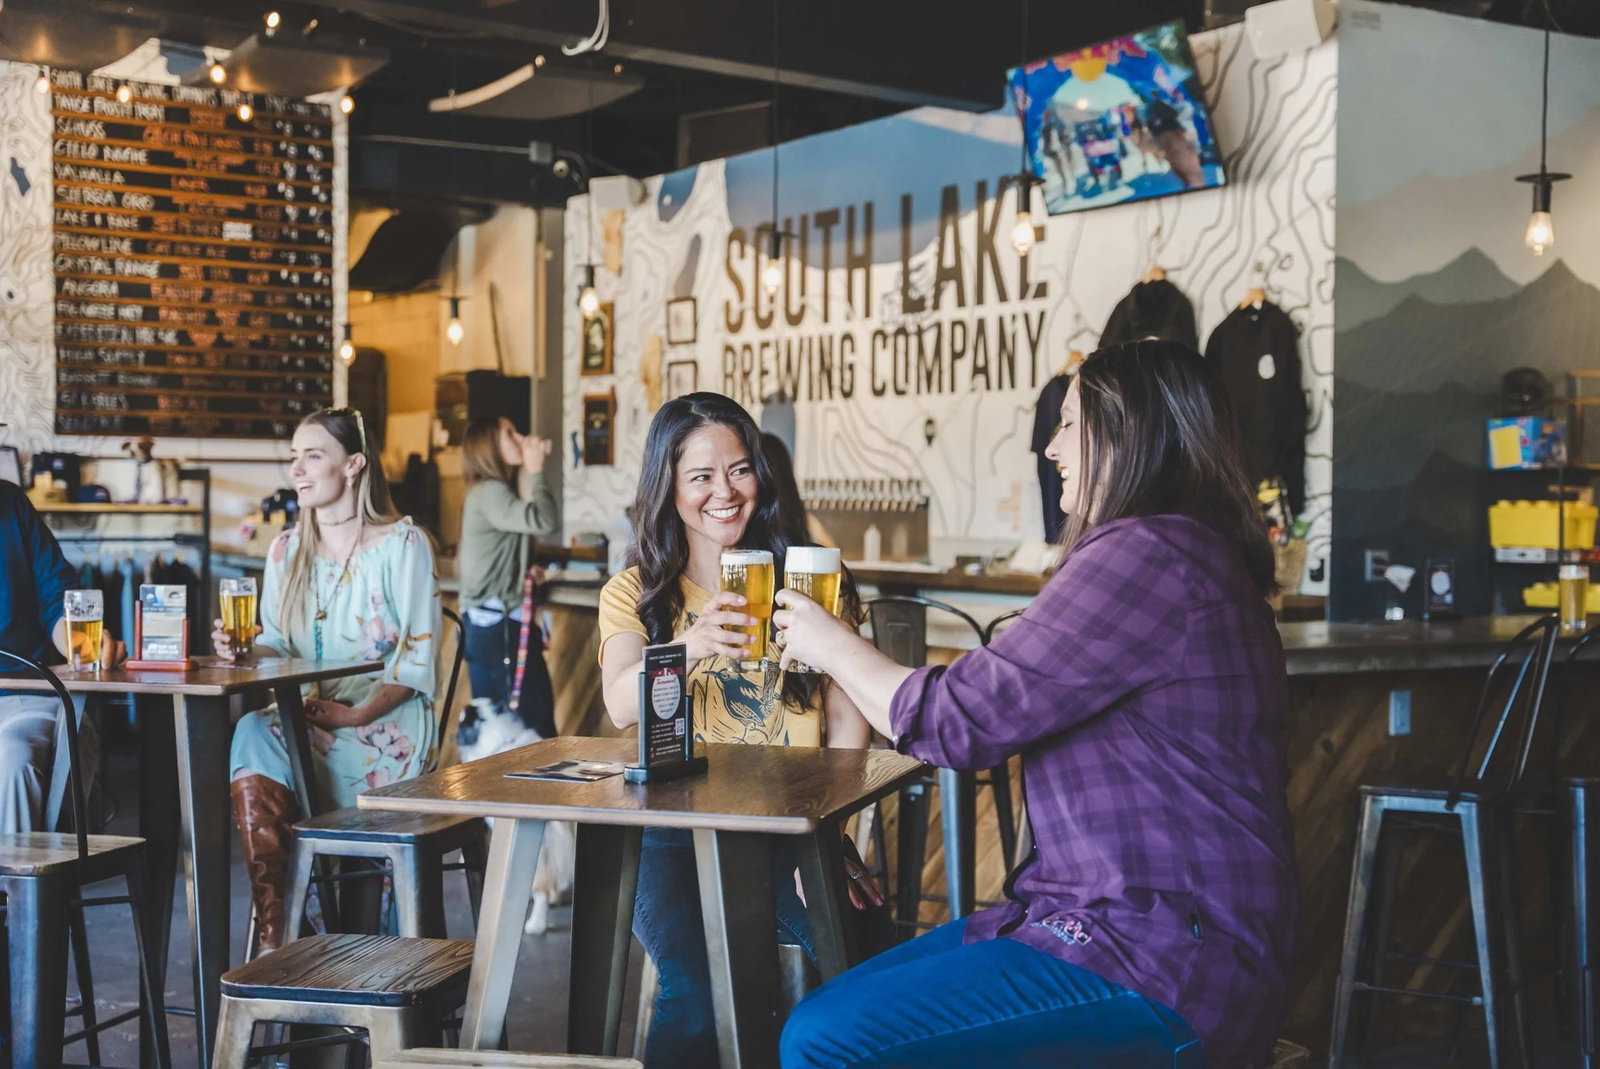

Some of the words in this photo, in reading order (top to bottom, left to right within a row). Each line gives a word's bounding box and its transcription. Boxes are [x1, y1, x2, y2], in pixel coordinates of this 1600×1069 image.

[54, 163, 126, 186] VALHALLA
[56, 185, 117, 208] SIERRA
[121, 191, 156, 211] ORO
[724, 201, 874, 334] SOUTH
[902, 175, 1048, 315] LAKE
[722, 332, 856, 404] BREWING
[872, 310, 1046, 398] COMPANY
